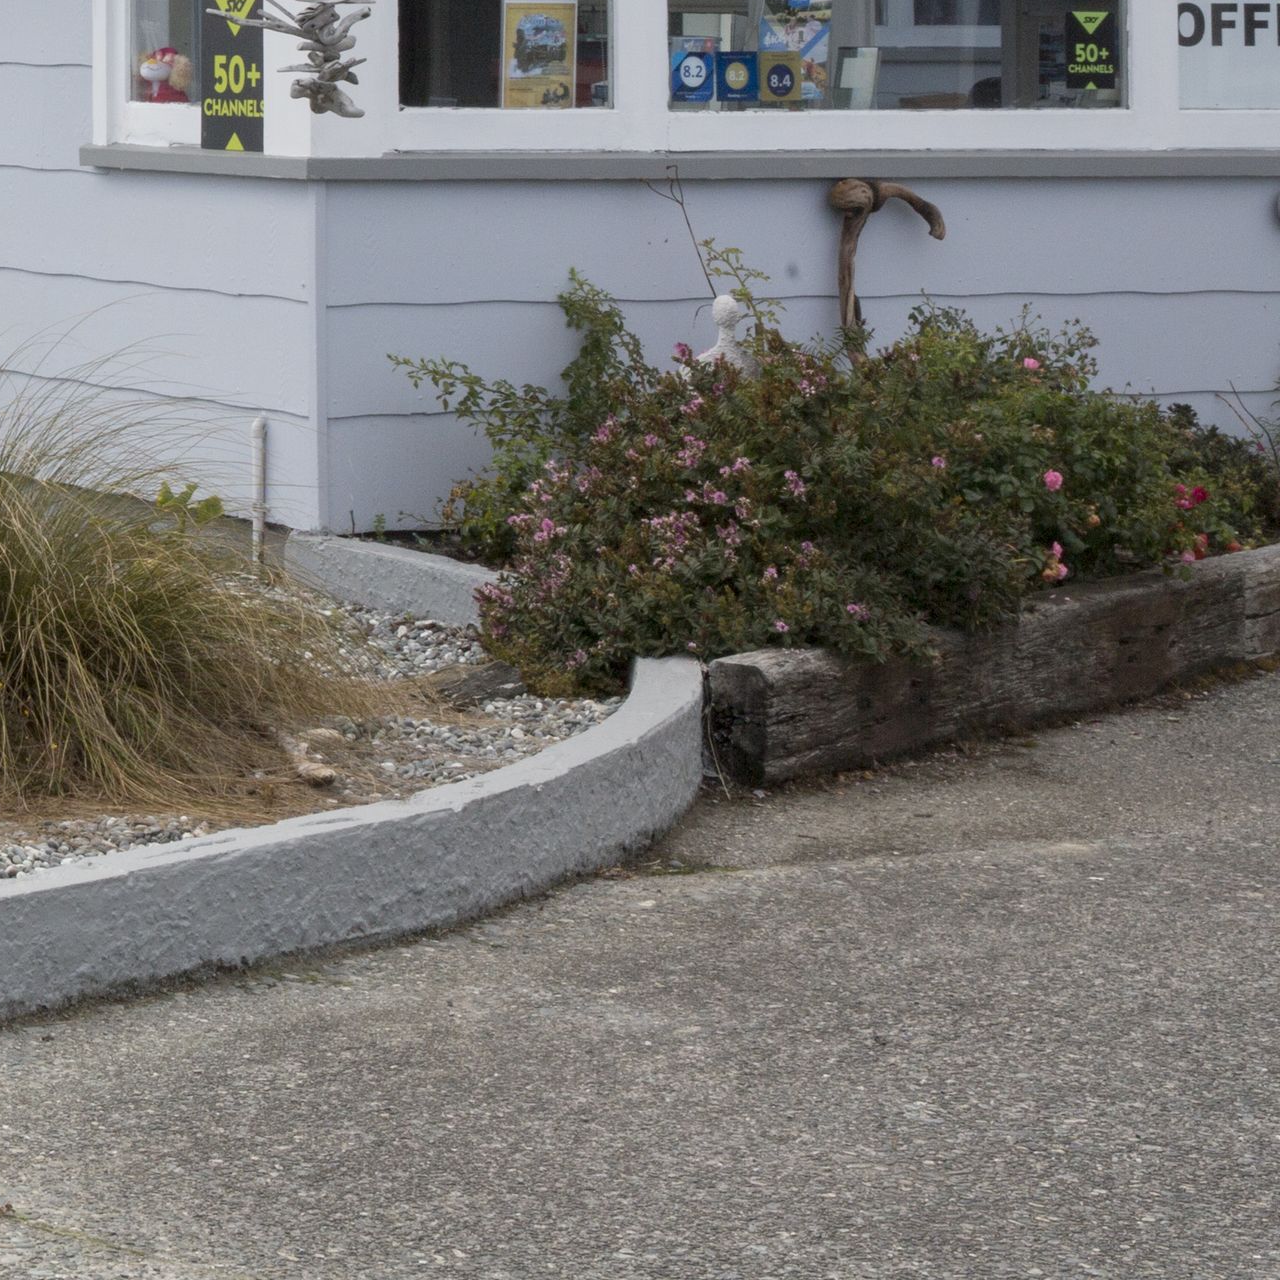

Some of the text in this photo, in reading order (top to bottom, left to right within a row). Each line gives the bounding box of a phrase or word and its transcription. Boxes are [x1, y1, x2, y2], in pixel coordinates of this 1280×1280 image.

[1177, 2, 1280, 47] OFF
[1075, 43, 1110, 63] 50+
[213, 54, 261, 94] 50+
[682, 65, 703, 79] 8.2
[728, 69, 745, 82] 8.2
[1068, 63, 1114, 74] CHANNELS
[769, 74, 792, 88] 8.4
[203, 97, 265, 118] CHANNELS
